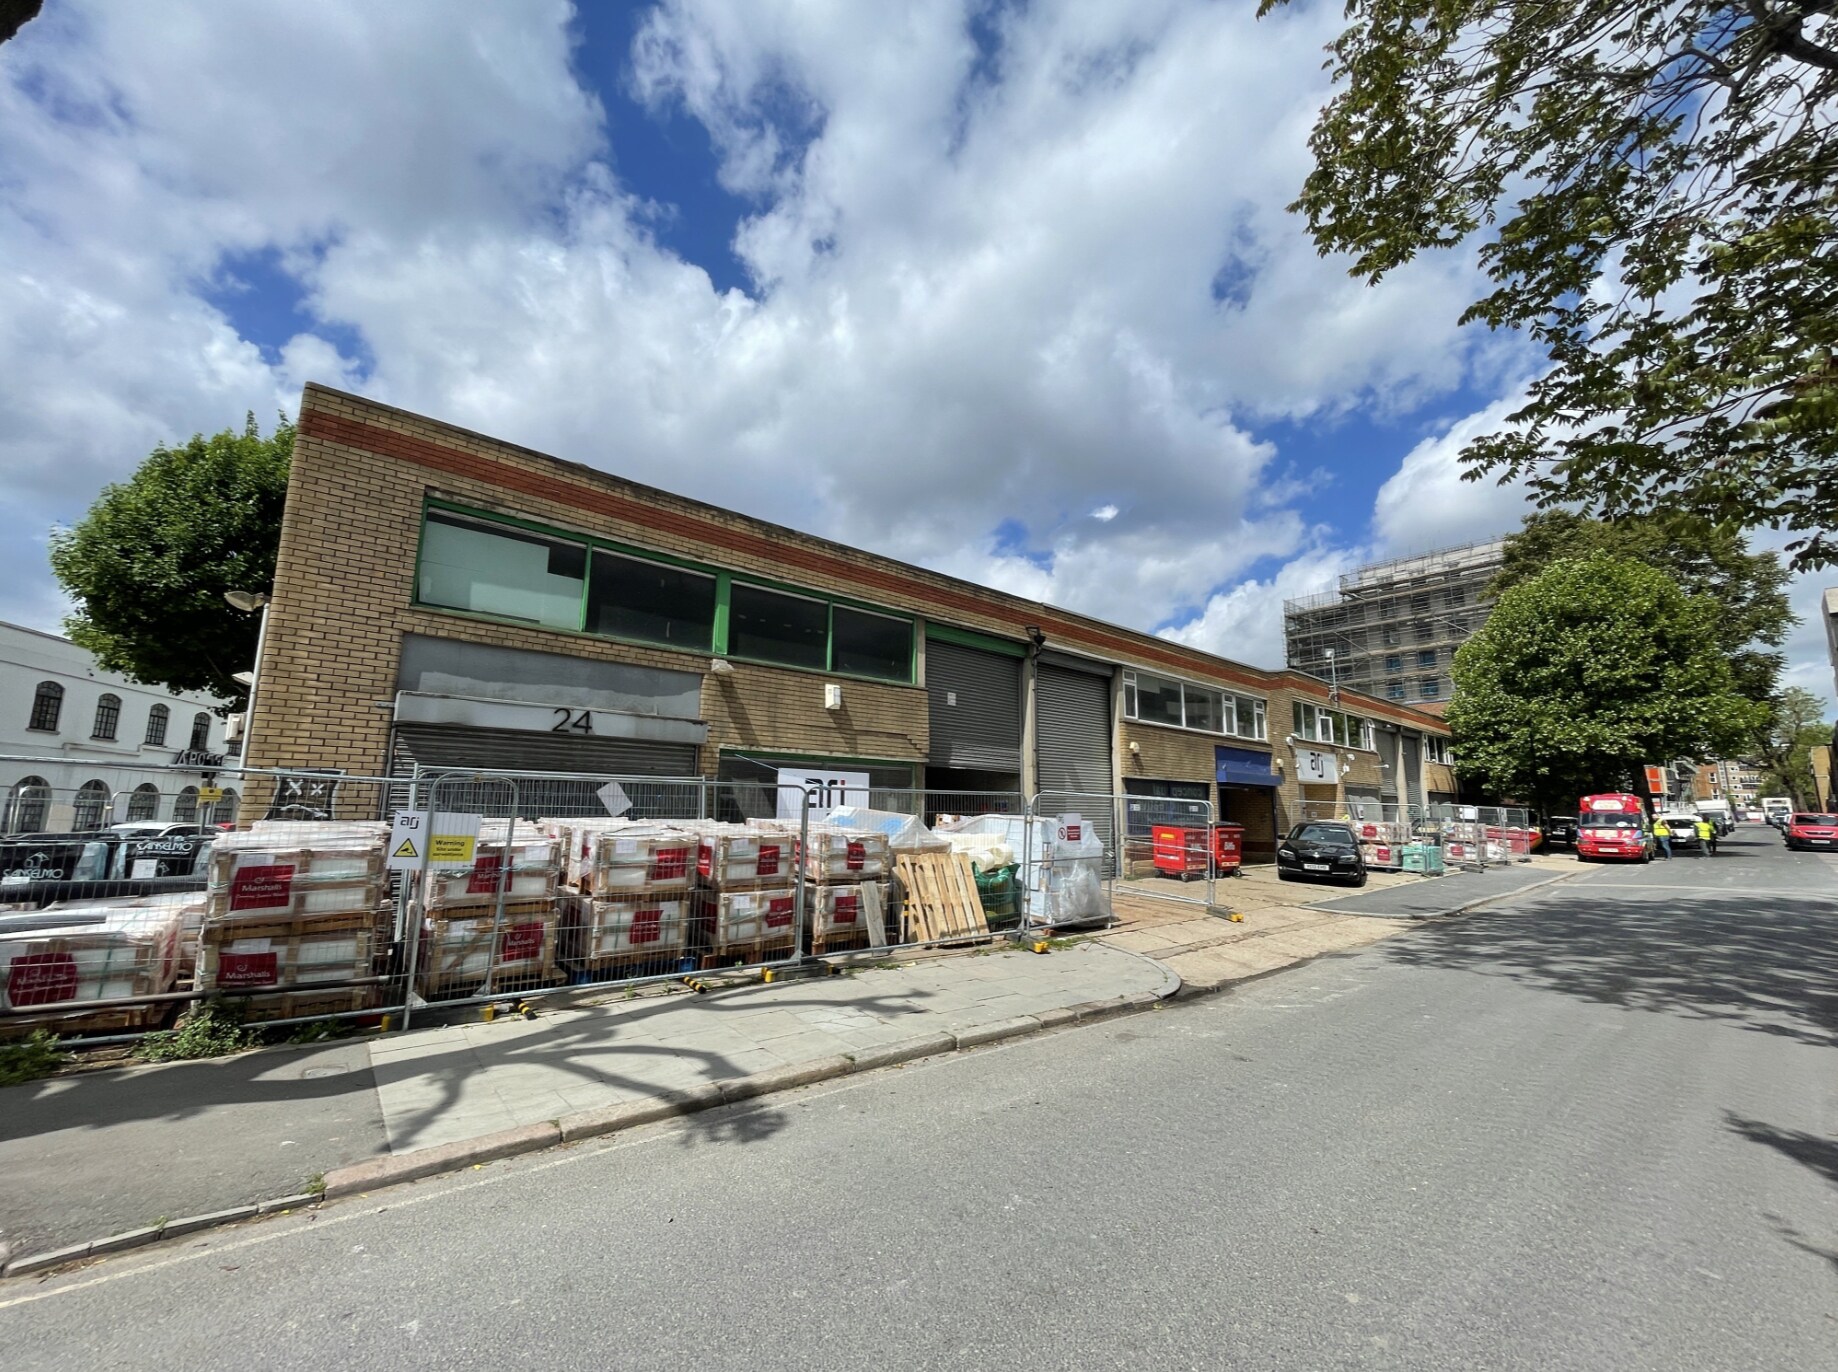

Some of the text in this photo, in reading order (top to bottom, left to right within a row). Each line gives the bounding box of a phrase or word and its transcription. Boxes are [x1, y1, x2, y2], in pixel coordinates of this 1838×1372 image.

[552, 708, 592, 734] 24
[400, 816, 420, 829] arj
[241, 884, 282, 892] Marshalls
[225, 971, 270, 979] Marshalls
